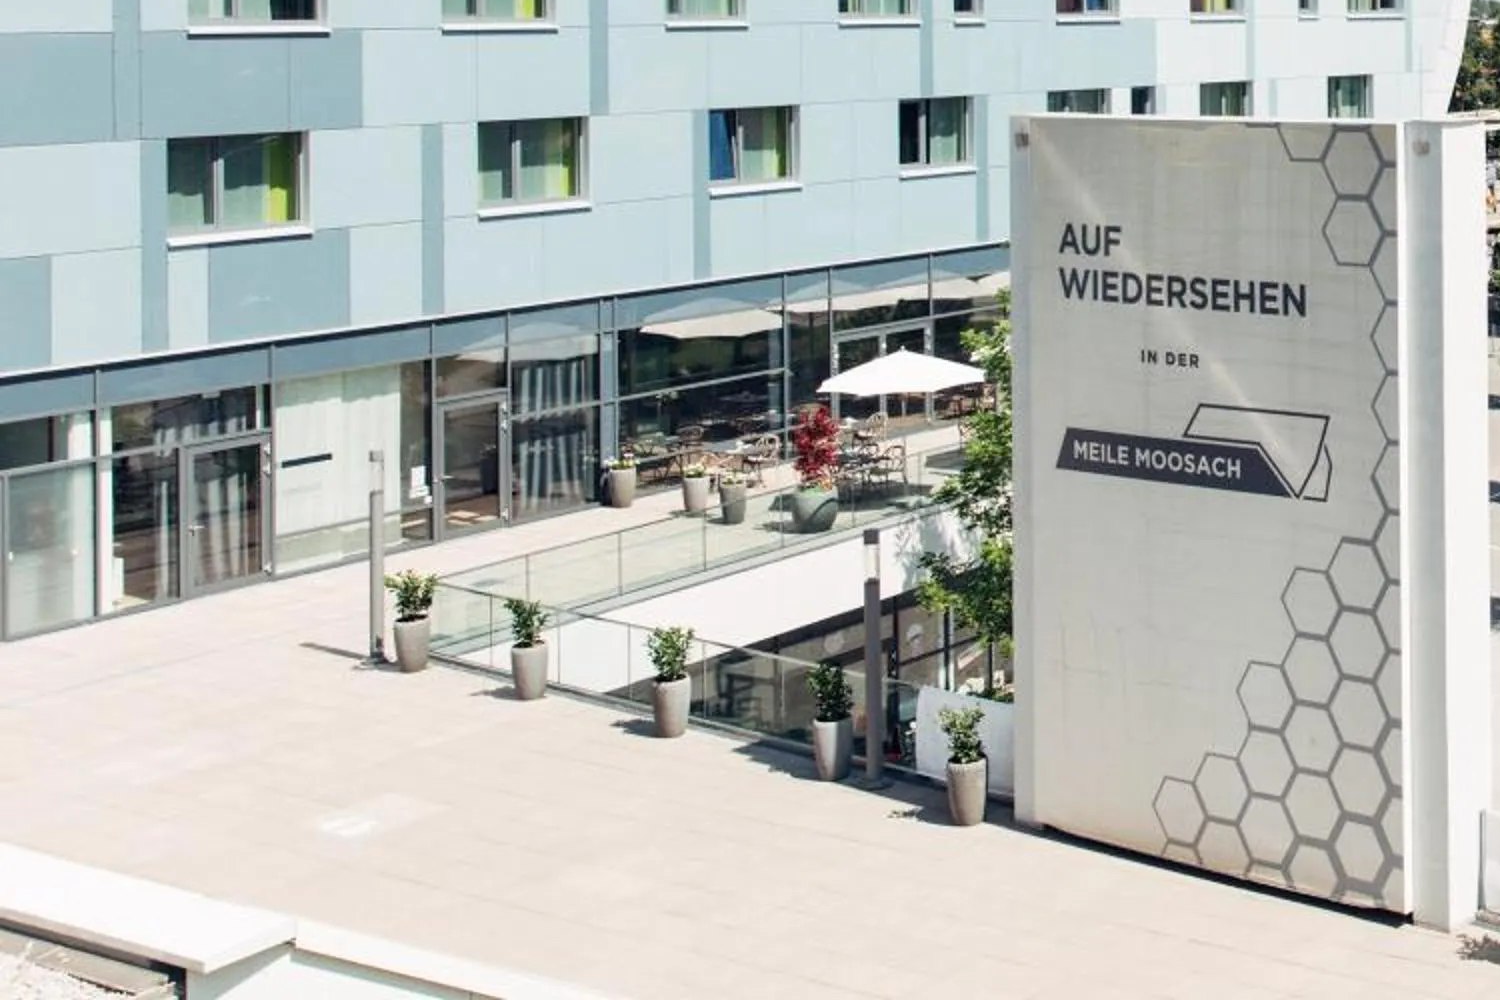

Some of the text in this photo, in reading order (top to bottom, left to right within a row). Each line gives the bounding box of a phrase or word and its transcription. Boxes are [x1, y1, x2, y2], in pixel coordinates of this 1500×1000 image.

[1058, 222, 1123, 257] AUF
[1058, 266, 1308, 318] WIEDERSEHEN
[1140, 348, 1200, 369] IN DER
[1072, 439, 1242, 480] MEILE MOOSACH
